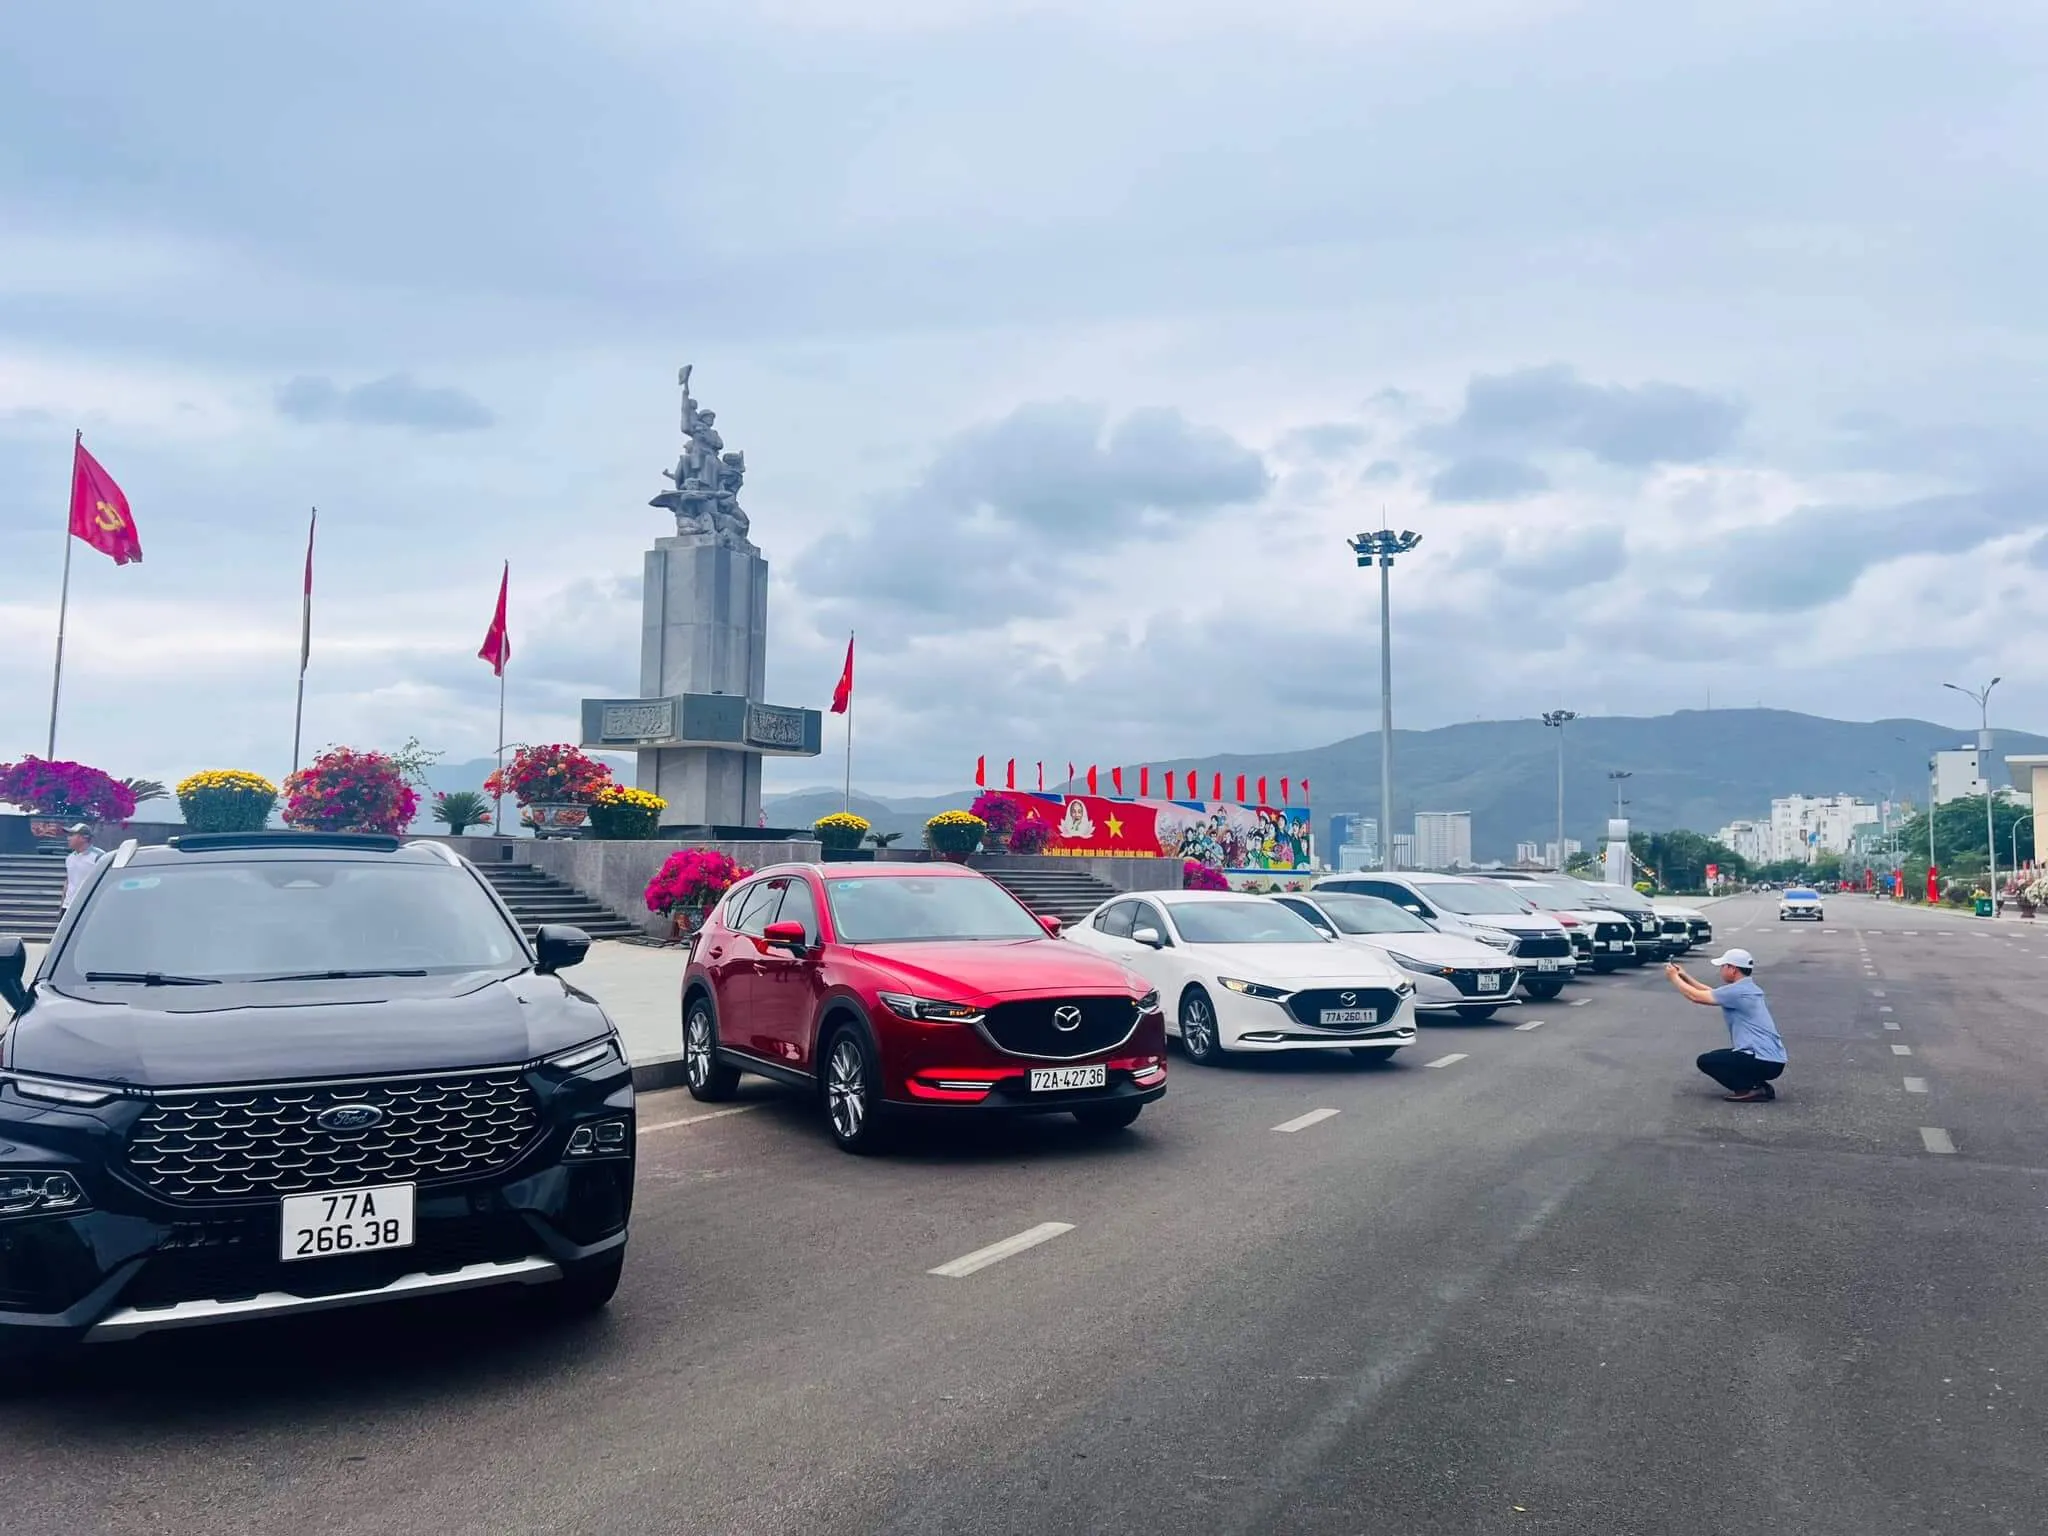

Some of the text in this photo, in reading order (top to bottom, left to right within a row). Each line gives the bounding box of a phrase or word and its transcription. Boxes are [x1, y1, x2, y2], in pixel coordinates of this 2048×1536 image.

[1034, 1068, 1103, 1089] 72A-427.36
[333, 1110, 368, 1125] Ford
[322, 1192, 376, 1222] 77A
[297, 1219, 399, 1255] 266.38
